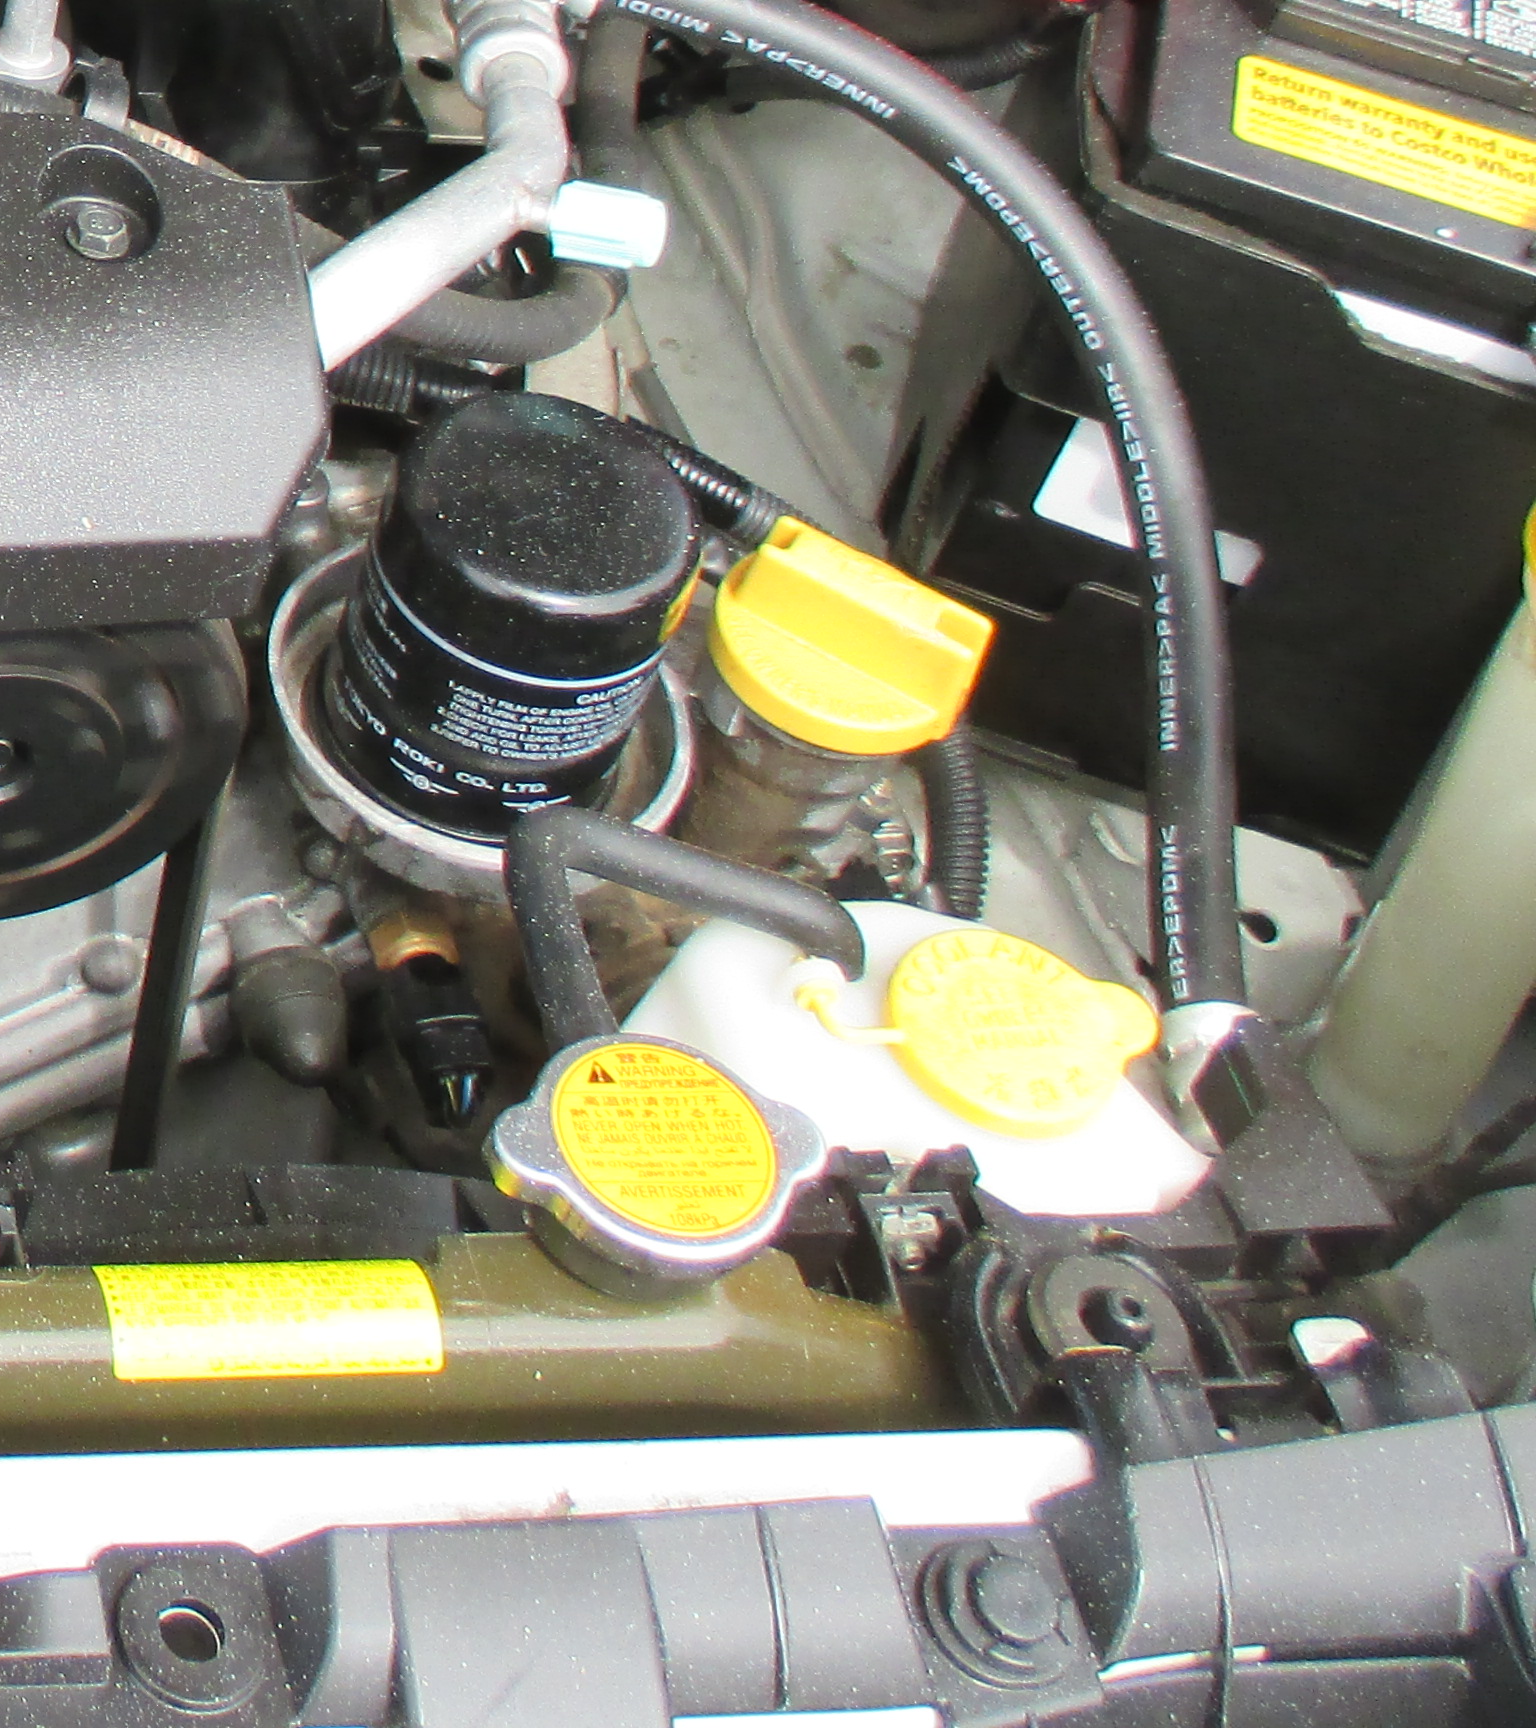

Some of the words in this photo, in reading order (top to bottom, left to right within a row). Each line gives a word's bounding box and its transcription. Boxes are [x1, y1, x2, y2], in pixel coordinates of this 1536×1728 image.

[1253, 66, 1332, 101] Return
[1340, 93, 1445, 140] warranty
[1452, 131, 1496, 154] and
[1250, 85, 1356, 130] batteries
[1362, 123, 1384, 139] to
[1390, 130, 1468, 166] Costco
[393, 735, 445, 774] ROKI
[616, 1065, 697, 1077] WARNING
[573, 1120, 619, 1132] NEVER
[623, 1120, 661, 1132] OPEN
[667, 1119, 710, 1131] WHEN
[576, 1133, 592, 1145] NE
[597, 1133, 640, 1145] JAMAIS
[644, 1133, 690, 1144] OUVRIR
[619, 1184, 746, 1199] AVERTISSEMENT
